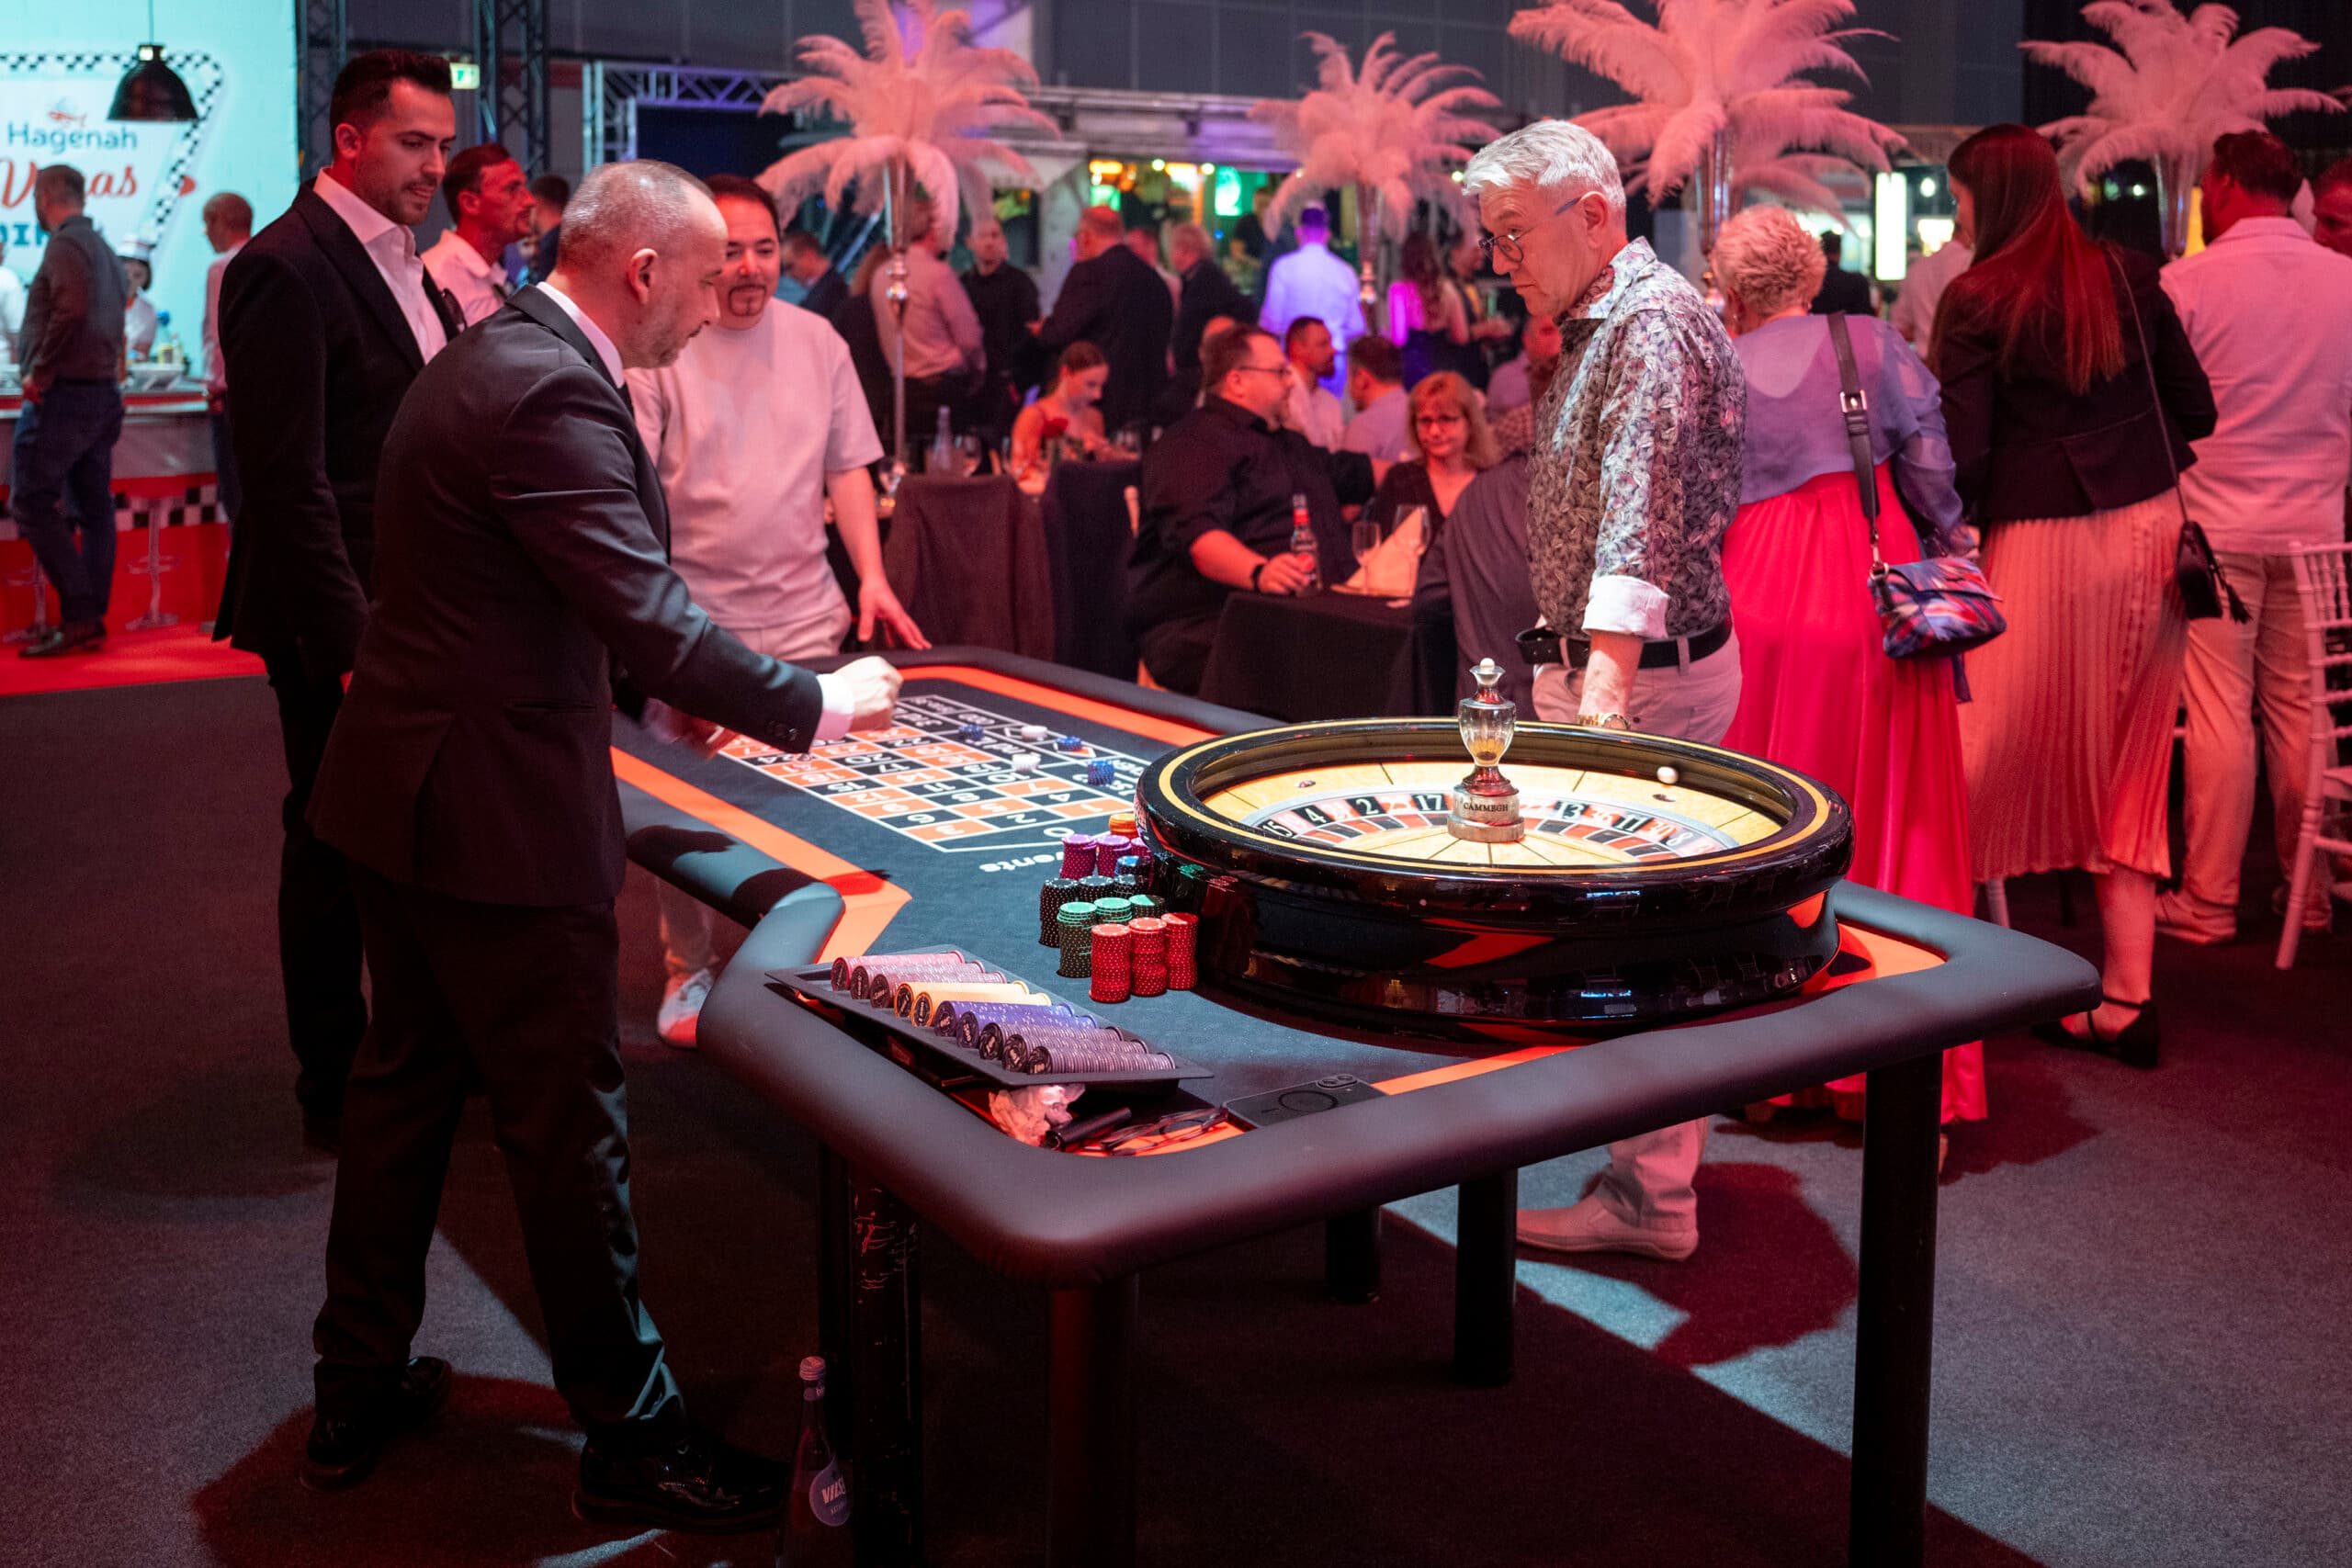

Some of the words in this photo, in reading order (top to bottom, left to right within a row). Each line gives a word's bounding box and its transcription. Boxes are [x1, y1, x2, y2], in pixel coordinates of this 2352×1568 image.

[7, 122, 138, 154] Hagenah
[0, 159, 137, 208] Vas
[845, 753, 892, 764] 20
[879, 763, 910, 773] 17
[963, 763, 1002, 773] 13
[897, 773, 935, 783] 14
[988, 772, 1030, 782] 10
[828, 782, 866, 793] 15
[923, 782, 956, 792] 11
[1028, 783, 1050, 792] 7
[849, 792, 890, 802] 12
[952, 792, 980, 802] 8
[1048, 793, 1070, 802] 4
[882, 803, 910, 812] 9
[979, 803, 1008, 812] 5
[1080, 803, 1102, 812] 1
[1356, 798, 1379, 815] 2
[1416, 795, 1442, 811] 17
[1463, 802, 1508, 812] CAMMEGH
[1305, 808, 1327, 823] 4
[1555, 802, 1585, 820] 13
[908, 813, 935, 823] 6
[1007, 813, 1036, 824] 2
[1617, 814, 1650, 831] 11
[935, 825, 965, 835] 3
[1043, 827, 1075, 837] 0
[1262, 820, 1293, 837] 15
[820, 1476, 846, 1505] VILS
